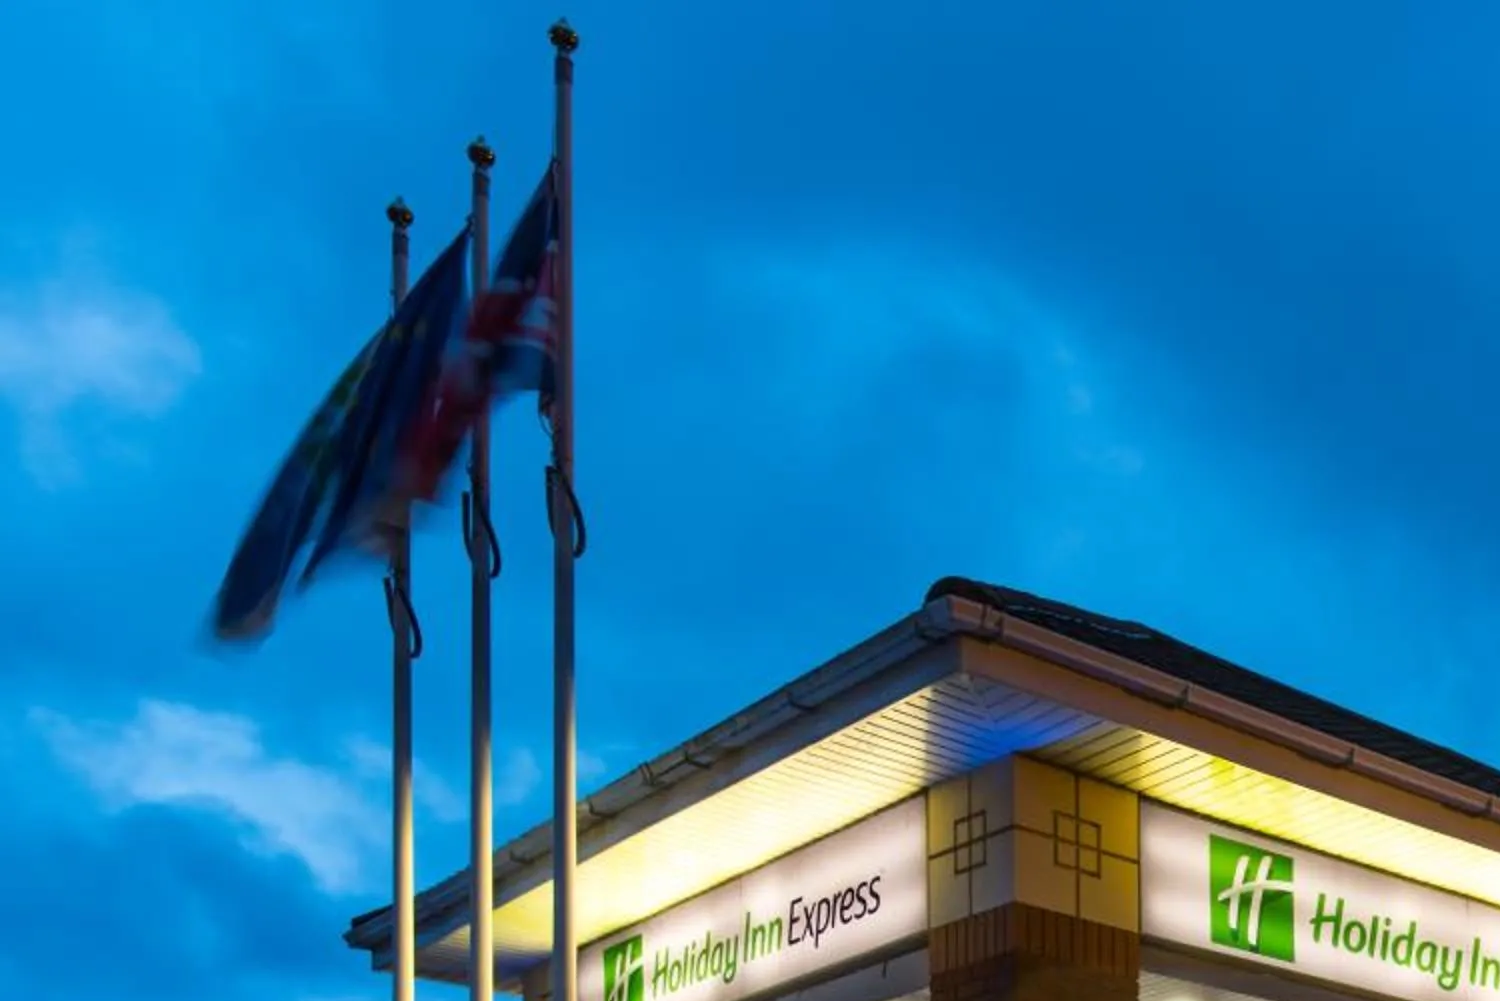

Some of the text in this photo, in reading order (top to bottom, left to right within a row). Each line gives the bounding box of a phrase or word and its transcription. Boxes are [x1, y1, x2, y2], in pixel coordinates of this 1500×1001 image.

[652, 930, 739, 1000] Holiday
[743, 911, 783, 964] Inn
[787, 875, 881, 949] Express
[1310, 893, 1464, 991] Holiday
